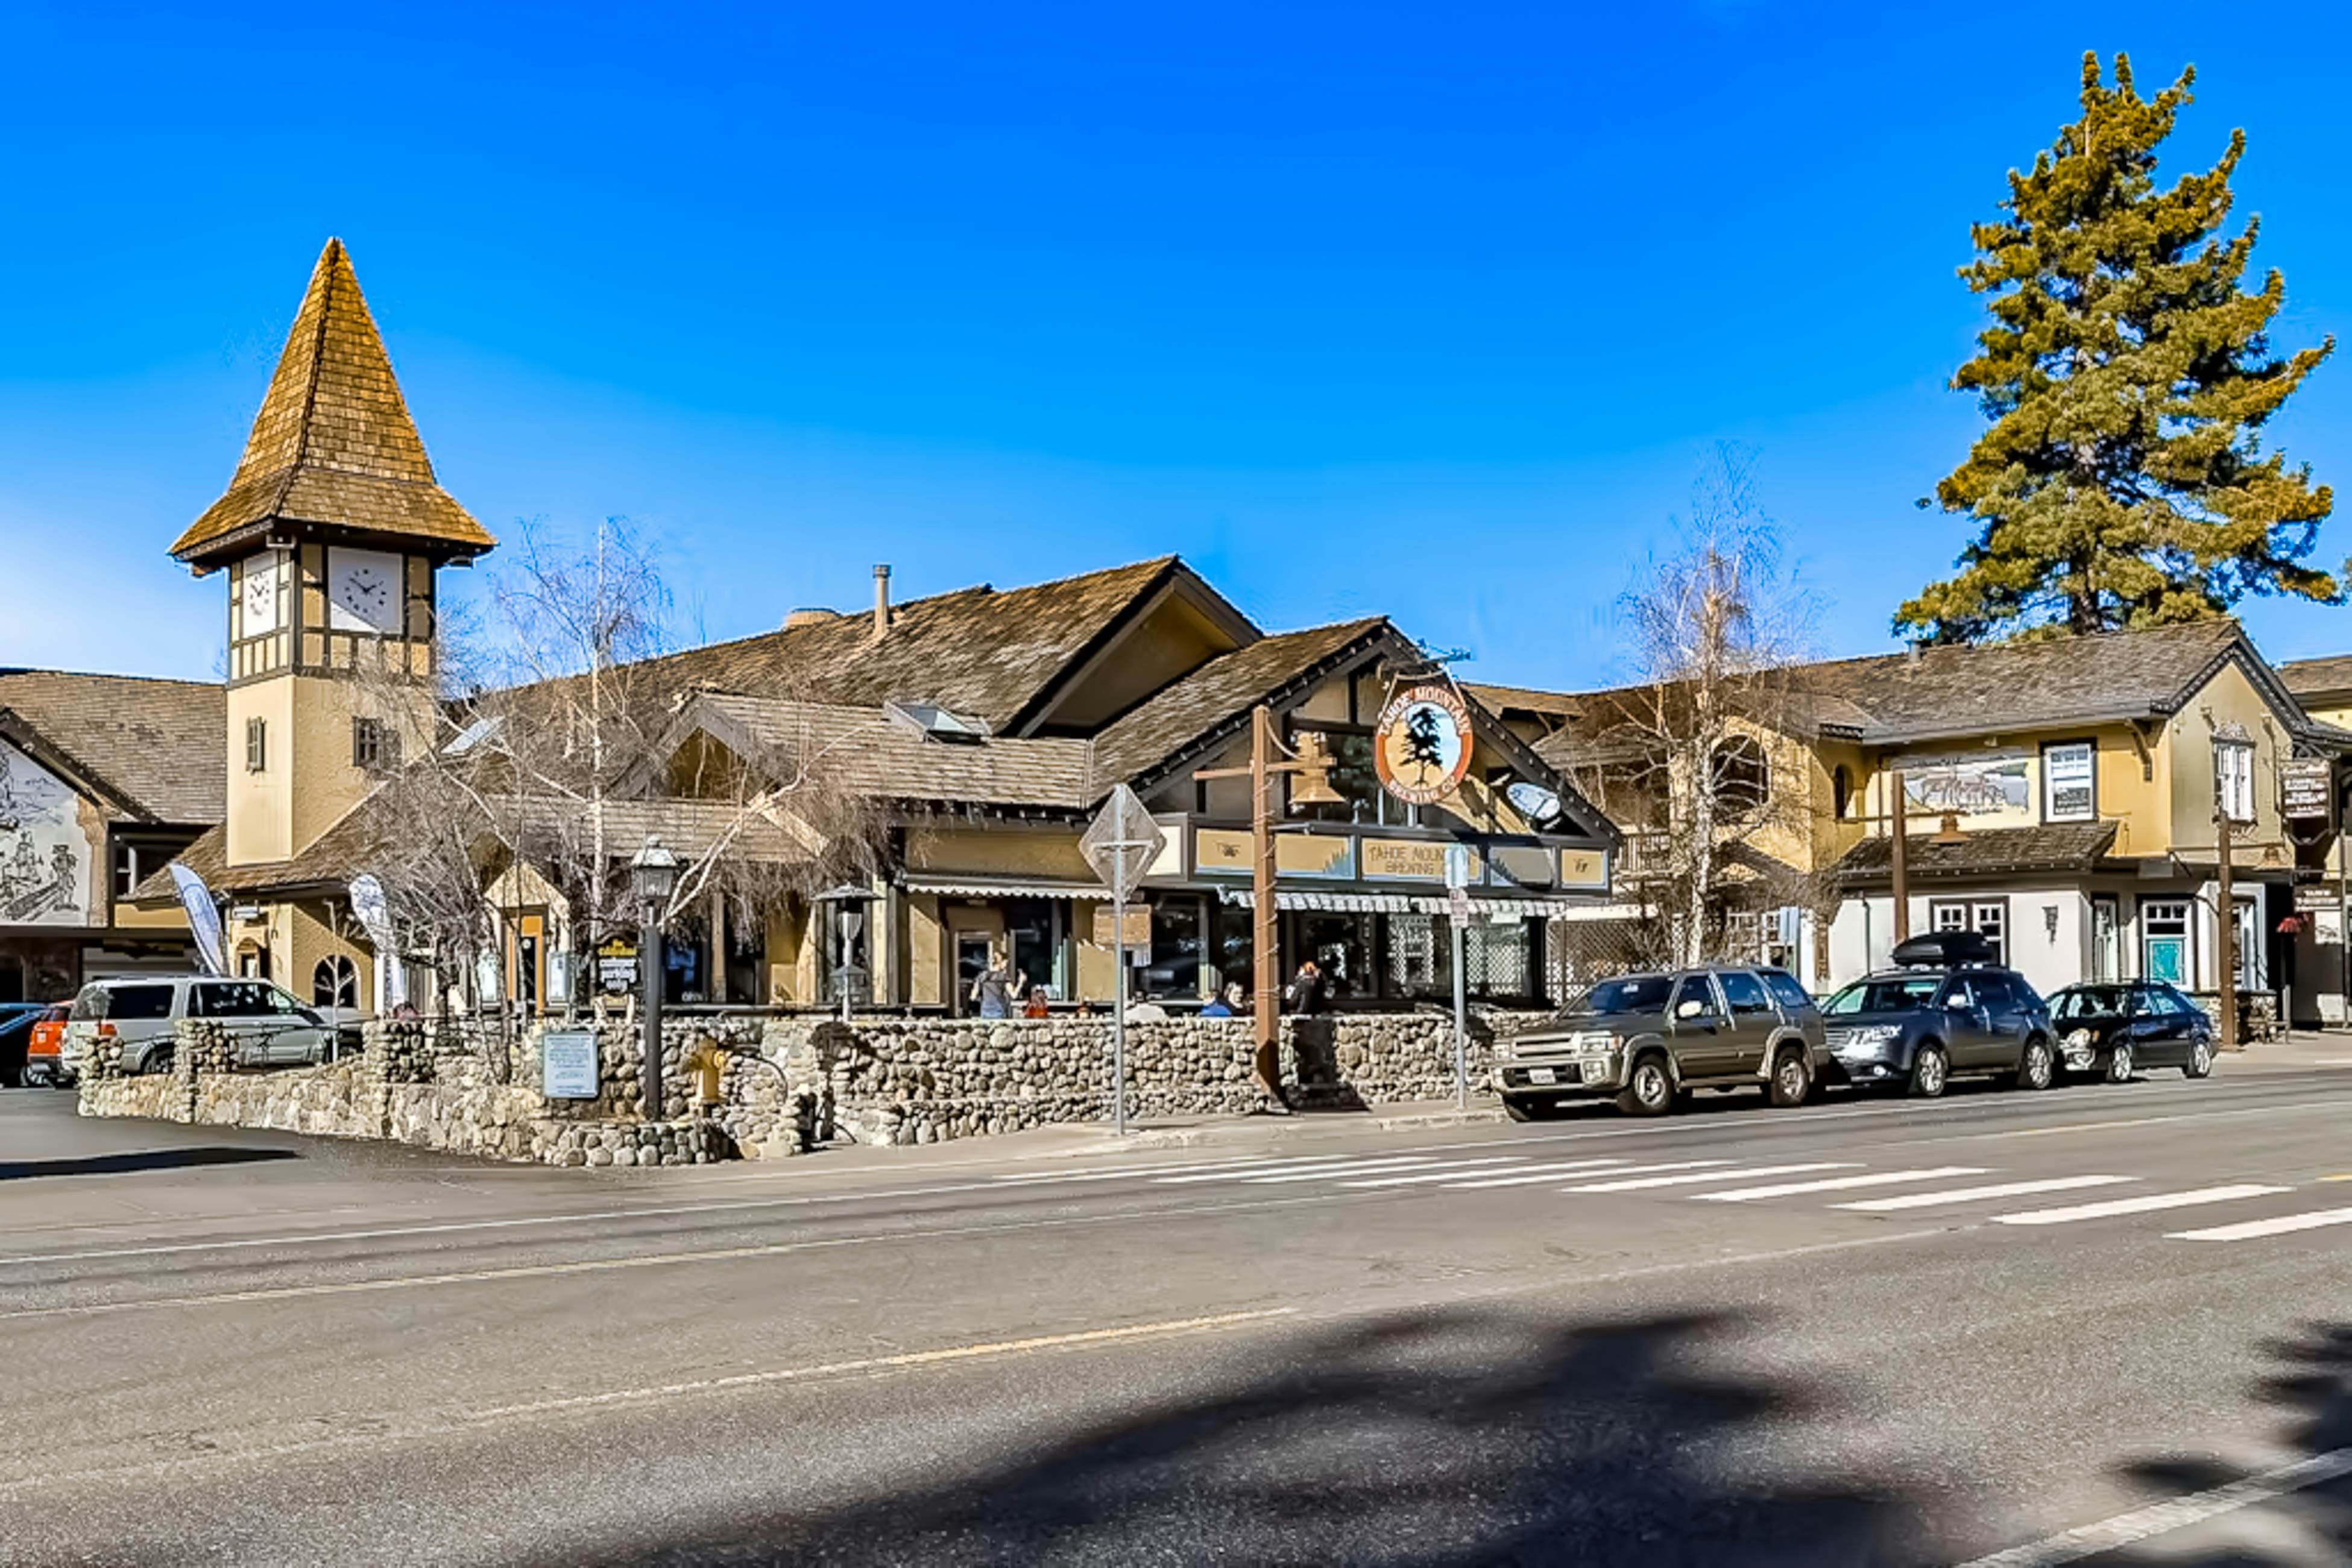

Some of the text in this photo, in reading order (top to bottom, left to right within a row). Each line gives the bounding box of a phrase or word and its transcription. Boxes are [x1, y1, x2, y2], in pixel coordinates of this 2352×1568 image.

[1378, 685, 1472, 735] TAHOE MOUNTAIN
[1389, 779, 1439, 804] BREWING
[1369, 846, 1407, 862] TAHOE
[1386, 863, 1434, 875] BREWING
